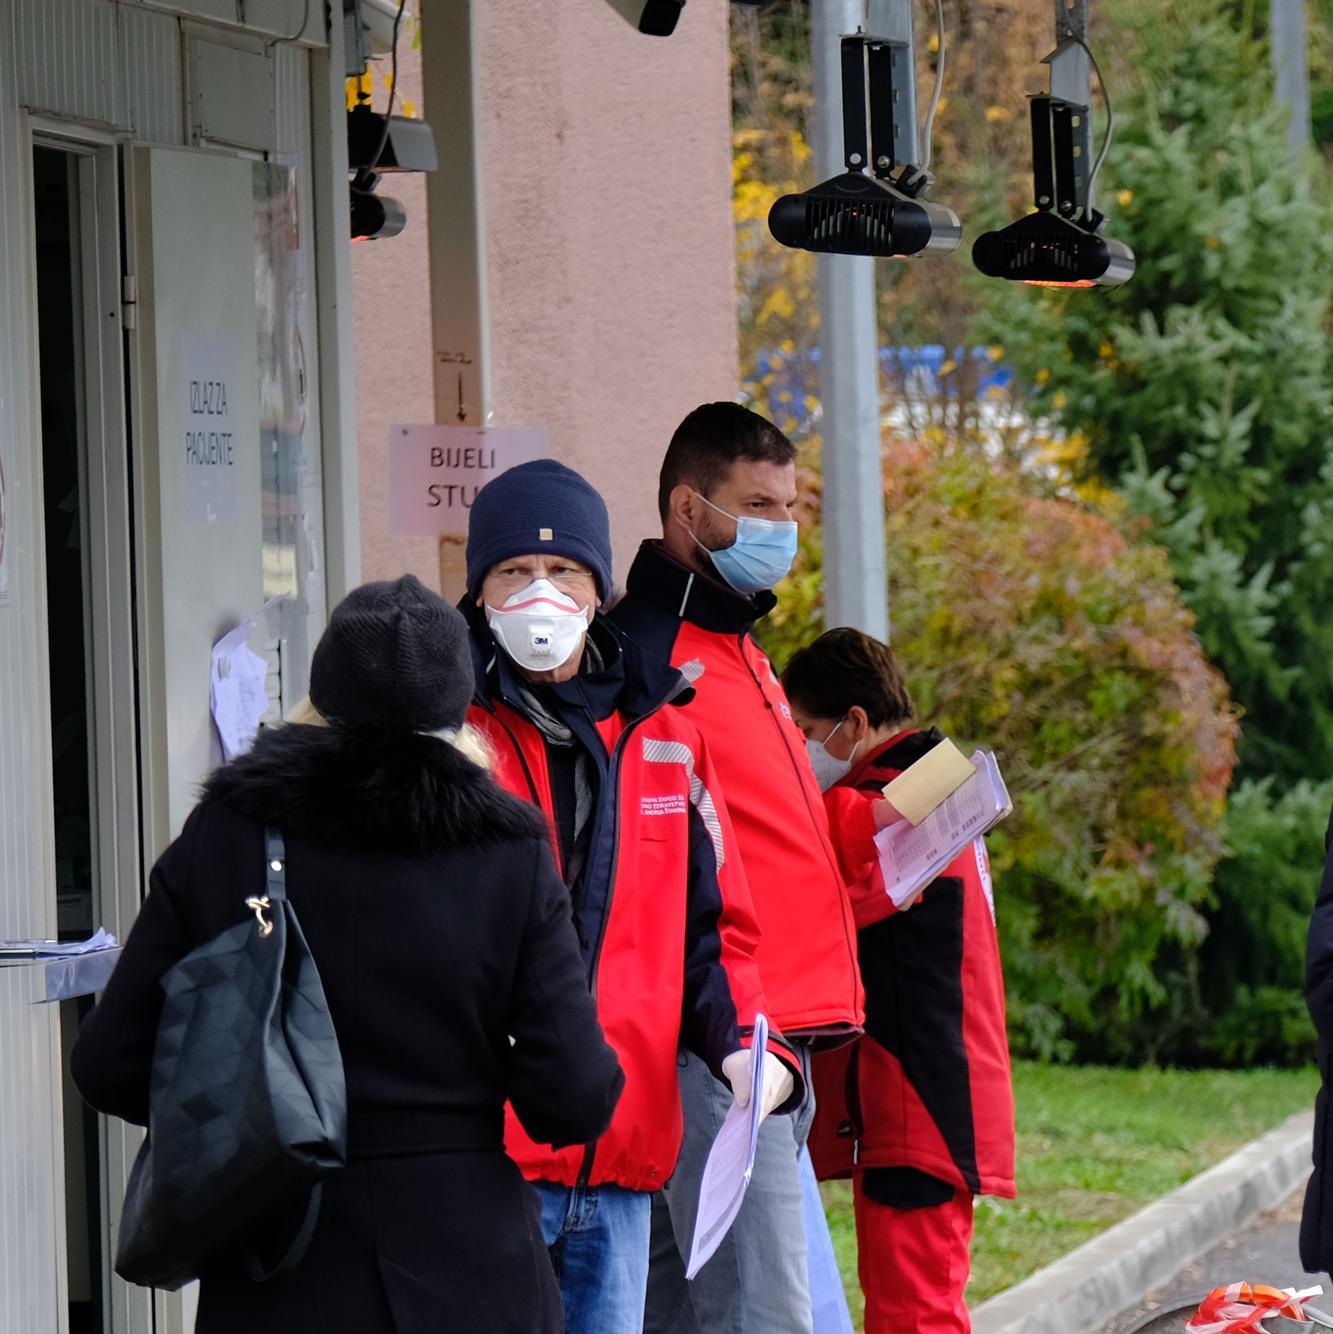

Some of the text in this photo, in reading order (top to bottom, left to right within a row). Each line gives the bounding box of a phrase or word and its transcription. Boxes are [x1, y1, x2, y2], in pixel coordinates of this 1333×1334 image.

[186, 432, 233, 466] PACIJENTE
[430, 447, 496, 470] BIJELI
[427, 484, 478, 509] STU
[534, 637, 548, 645] 3M
